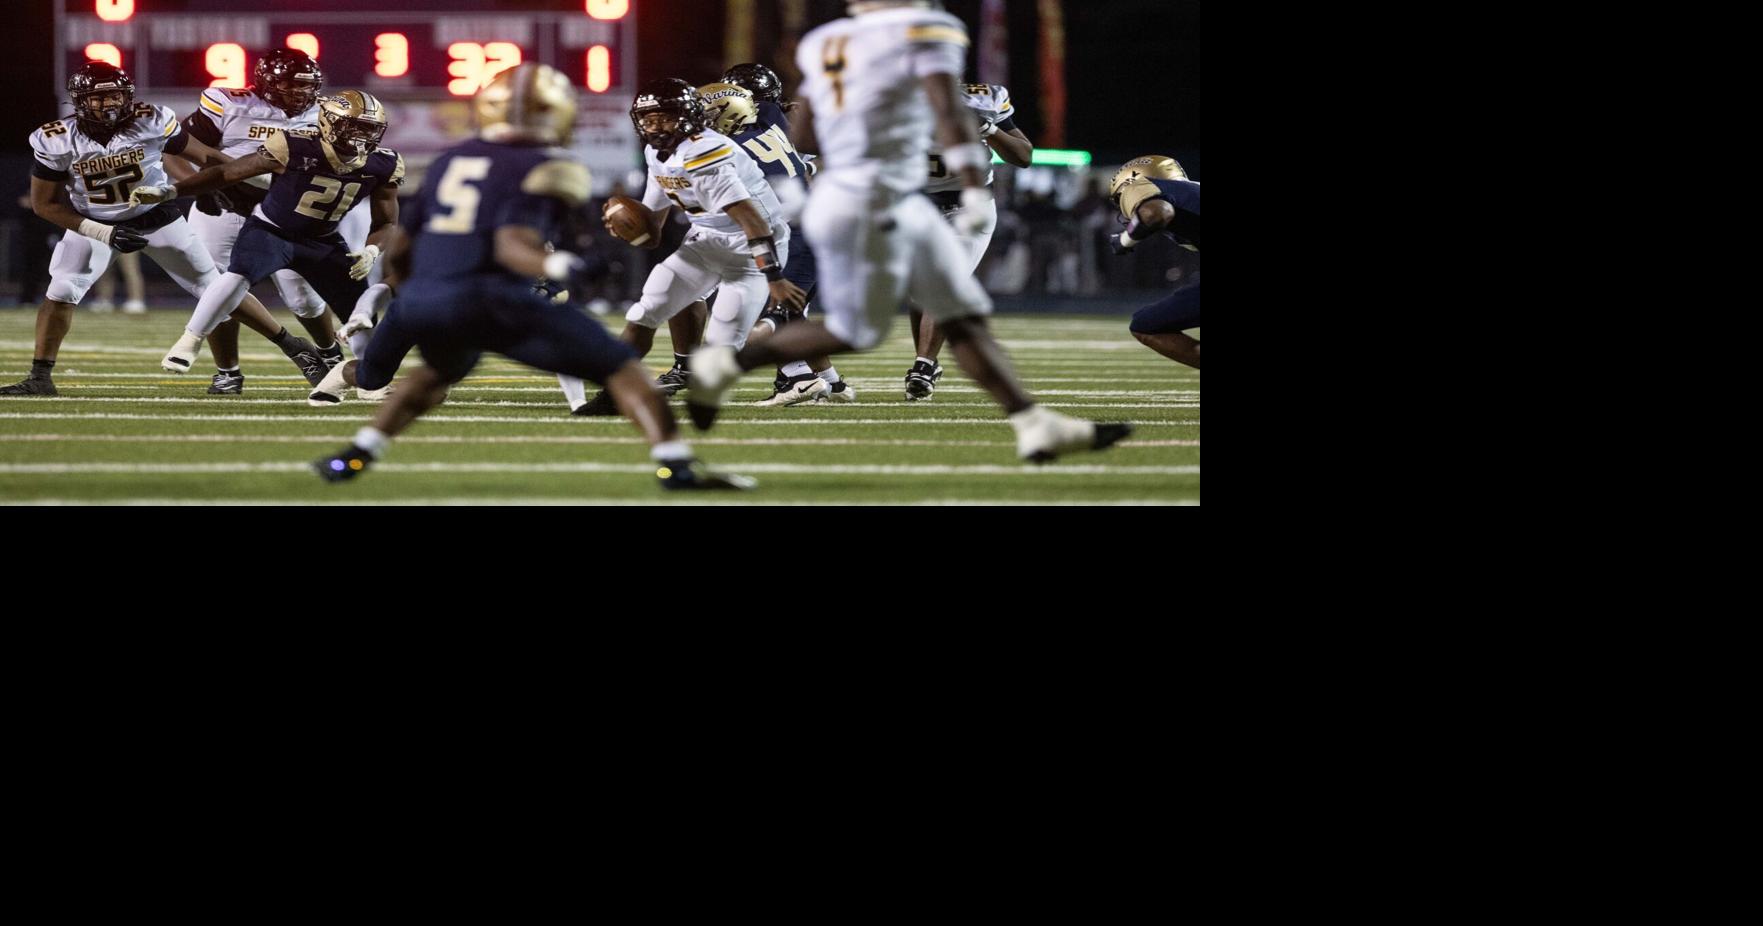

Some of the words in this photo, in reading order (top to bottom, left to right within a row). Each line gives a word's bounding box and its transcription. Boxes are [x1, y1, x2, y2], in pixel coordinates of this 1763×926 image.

[205, 43, 246, 88] 9
[374, 33, 408, 77] 3
[822, 35, 849, 113] 4
[701, 88, 748, 105] Varina
[41, 120, 67, 139] 52
[72, 149, 145, 175] SPRINGERS
[83, 163, 145, 205] 52
[294, 175, 363, 222] 21
[423, 155, 493, 234] 5
